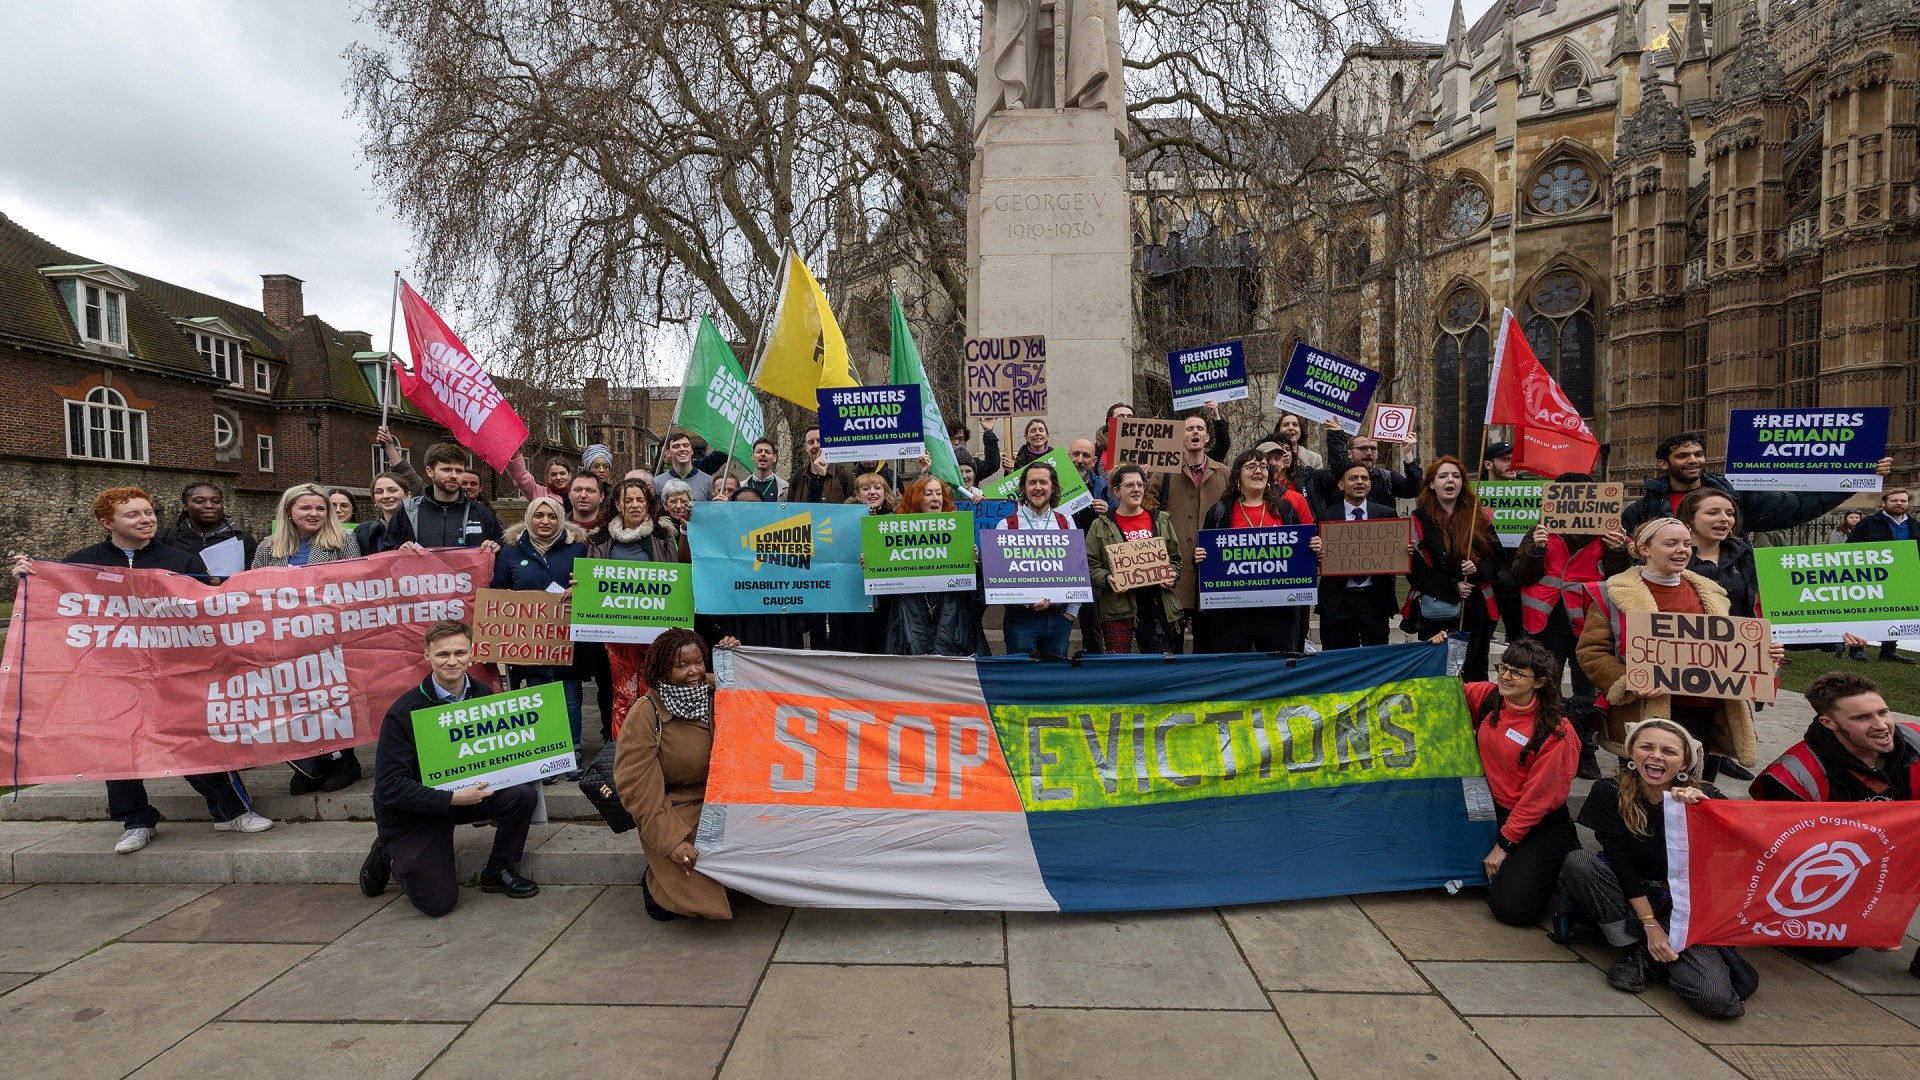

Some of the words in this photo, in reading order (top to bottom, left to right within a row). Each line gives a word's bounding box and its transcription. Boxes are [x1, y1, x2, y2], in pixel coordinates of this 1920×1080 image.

[995, 193, 1084, 211] GEORGE
[1091, 192, 1107, 209] V
[964, 339, 1021, 362] COULD
[1023, 338, 1046, 360] YOU
[1179, 346, 1233, 364] #RENTERS
[1184, 357, 1230, 374] DEMAND
[1306, 351, 1367, 383] #RENTERS
[967, 363, 1000, 388] PAY
[1003, 363, 1045, 388] 95%
[1188, 368, 1228, 384] ACTION
[1218, 378, 1244, 388] EVICTIONS
[1305, 365, 1358, 392] DEMAND
[832, 390, 906, 405] #RENTERS
[1303, 378, 1351, 403] ACTION
[969, 390, 1010, 413] MORE
[1013, 388, 1048, 413] RENT?
[1291, 388, 1306, 397] MAKE
[1306, 393, 1325, 404] HOMES
[1325, 400, 1337, 409] SAFE
[1343, 407, 1355, 416] LIVE
[839, 403, 902, 418] DEMAND
[843, 416, 898, 431] ACTION
[1752, 412, 1864, 428] #RENTERS
[1120, 422, 1174, 439] REFORM
[1758, 428, 1855, 442] DEMAND
[1135, 438, 1153, 449] FOR
[1762, 443, 1846, 457] ACTION
[1119, 449, 1181, 467] RENTERS
[1548, 485, 1598, 500] SAFE
[1493, 509, 1540, 520] CTION
[1556, 500, 1620, 514] HOUSING
[756, 523, 812, 543] LONDON
[878, 517, 957, 534] #RENTERS
[1325, 523, 1406, 541] LANDLORD
[884, 532, 952, 548] DEMAND
[996, 534, 1070, 547] #RENTERS
[1109, 545, 1126, 555] WE
[1131, 540, 1163, 551] WANT
[1216, 531, 1299, 547] #RENTERS
[756, 543, 812, 554] RENTERS
[889, 546, 948, 562] ACTION
[1003, 546, 1067, 560] DEMAND
[1222, 545, 1293, 561] DEMAND
[1326, 540, 1402, 557] REGISTER
[756, 553, 811, 571] UNION
[1008, 559, 1064, 573] ACTION
[1113, 549, 1168, 570] HOUSING
[1226, 560, 1288, 575] ACTION
[1780, 549, 1894, 569] #RENTERS
[592, 565, 679, 582] #RENTERS
[1117, 564, 1173, 587] JUSTICE
[1790, 567, 1889, 585] DEMAND
[598, 580, 672, 596] DEMAND
[734, 580, 790, 590] DISABILITY
[792, 580, 832, 590] JUSTICE
[1215, 580, 1232, 588] END
[1233, 579, 1271, 587] NO-FAULT
[1271, 577, 1313, 585] EVICTIONS
[57, 592, 198, 619] STANDING
[203, 592, 249, 617] UP
[257, 587, 300, 612] TO
[305, 572, 472, 607] LANDLORDS
[763, 596, 804, 606] CAUCUS
[1799, 584, 1884, 603] ACTION
[486, 600, 548, 619] HONK
[601, 595, 666, 611] ACTION
[1807, 608, 1842, 616] RENTING
[1869, 605, 1919, 613] AFFORDABLE
[65, 624, 217, 649] STANDING
[220, 620, 266, 646] UP
[273, 612, 335, 641] FOR
[341, 599, 465, 633] RENTERS
[477, 622, 527, 638] YOUR
[1651, 613, 1735, 642] END
[472, 642, 491, 657] IS
[498, 643, 532, 659] TOO
[534, 644, 573, 663] HIGH
[1631, 636, 1728, 668] SECTION
[1731, 641, 1768, 675] 21
[207, 644, 348, 701] LONDON
[207, 684, 349, 724] RENTERS
[438, 693, 544, 728] #RENTERS
[207, 704, 355, 745] UNION
[449, 711, 540, 743] DEMAND
[458, 727, 536, 759] ACTION
[769, 703, 989, 800] STOP
[1026, 692, 1417, 801] EVICTIONS
[428, 771, 442, 780] TO
[445, 766, 466, 777] END
[467, 762, 487, 772] THE
[489, 750, 532, 767] RENTING
[534, 740, 568, 755] CRISIS!
[1755, 859, 1766, 872] of
[1763, 817, 1816, 859] Community
[1862, 896, 1879, 918] Now
